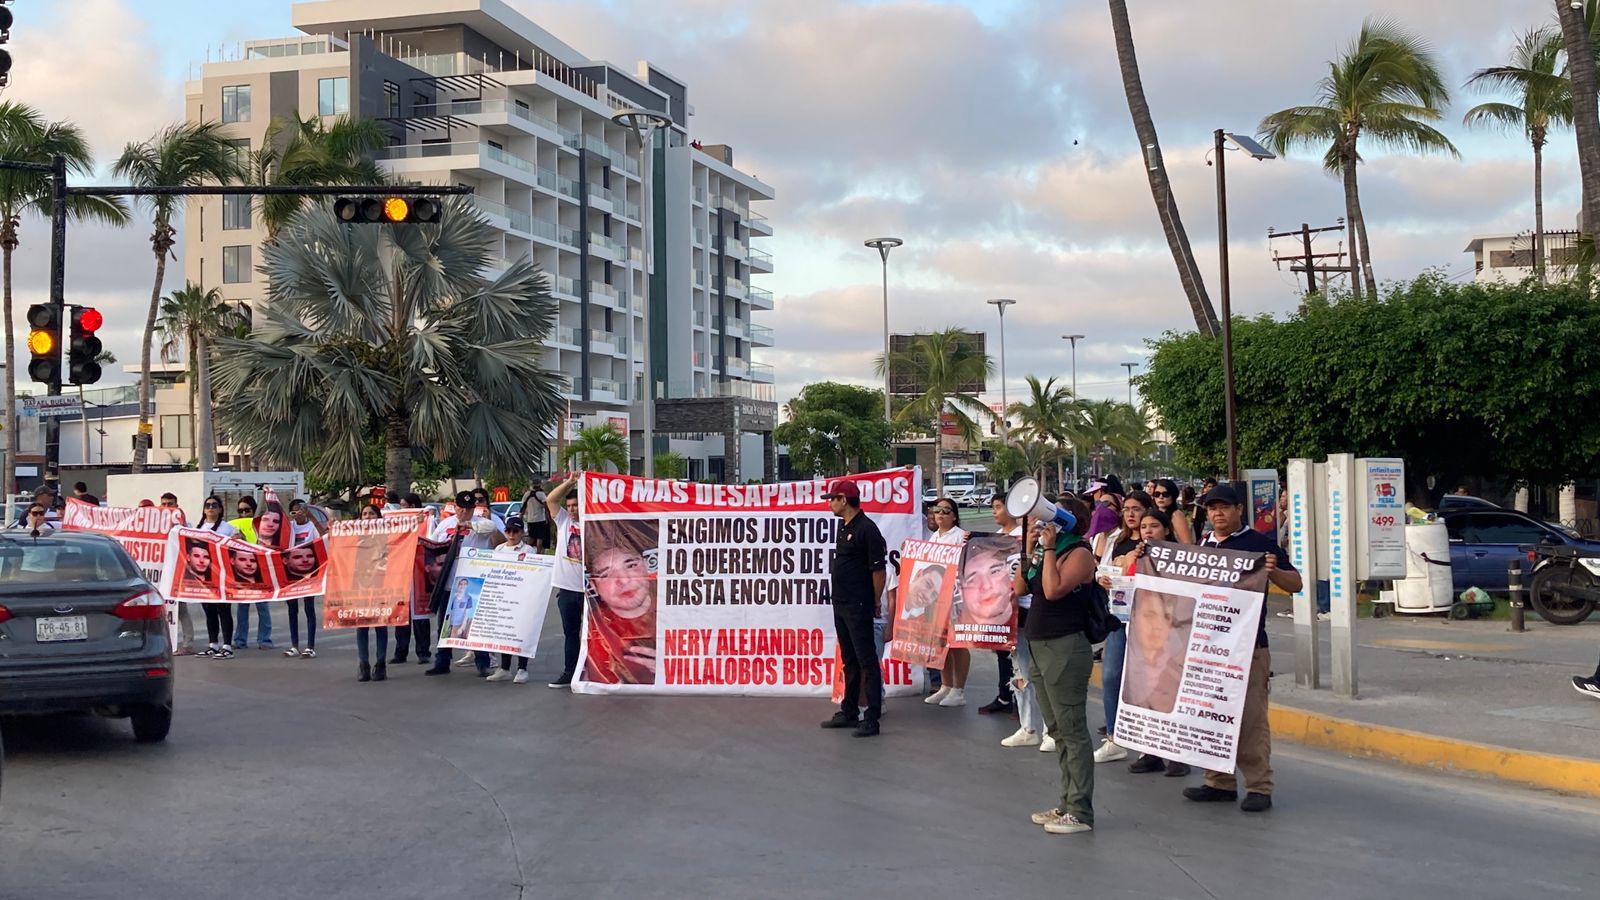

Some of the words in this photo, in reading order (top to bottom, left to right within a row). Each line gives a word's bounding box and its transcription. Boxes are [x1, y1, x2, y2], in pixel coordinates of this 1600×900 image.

[592, 478, 626, 504] NO
[631, 480, 688, 504] MAS
[695, 476, 910, 507] DESAPAREDOS
[331, 515, 418, 537] DESAPARECIDO
[667, 518, 758, 544] EXIGIMOS
[762, 517, 838, 544] JUSTICI
[1331, 490, 1342, 597] infinitum
[666, 548, 688, 575] LO
[692, 548, 795, 577] QUEREMOS
[801, 548, 823, 574] DE
[1150, 546, 1171, 560] SE
[1175, 550, 1228, 568] BUSCA
[1233, 557, 1255, 571] SU
[1156, 560, 1240, 583] PARADERO
[665, 578, 726, 606] HASTA
[1196, 612, 1232, 623] HERRERA
[1199, 602, 1240, 615] JHONATAN
[664, 628, 712, 657] NERY
[716, 628, 824, 656] ALEJANDRO
[1191, 643, 1201, 652] 27
[1202, 645, 1230, 657] AÑOS
[664, 658, 778, 686] VILLALOBOS
[1197, 709, 1235, 725] APROX
